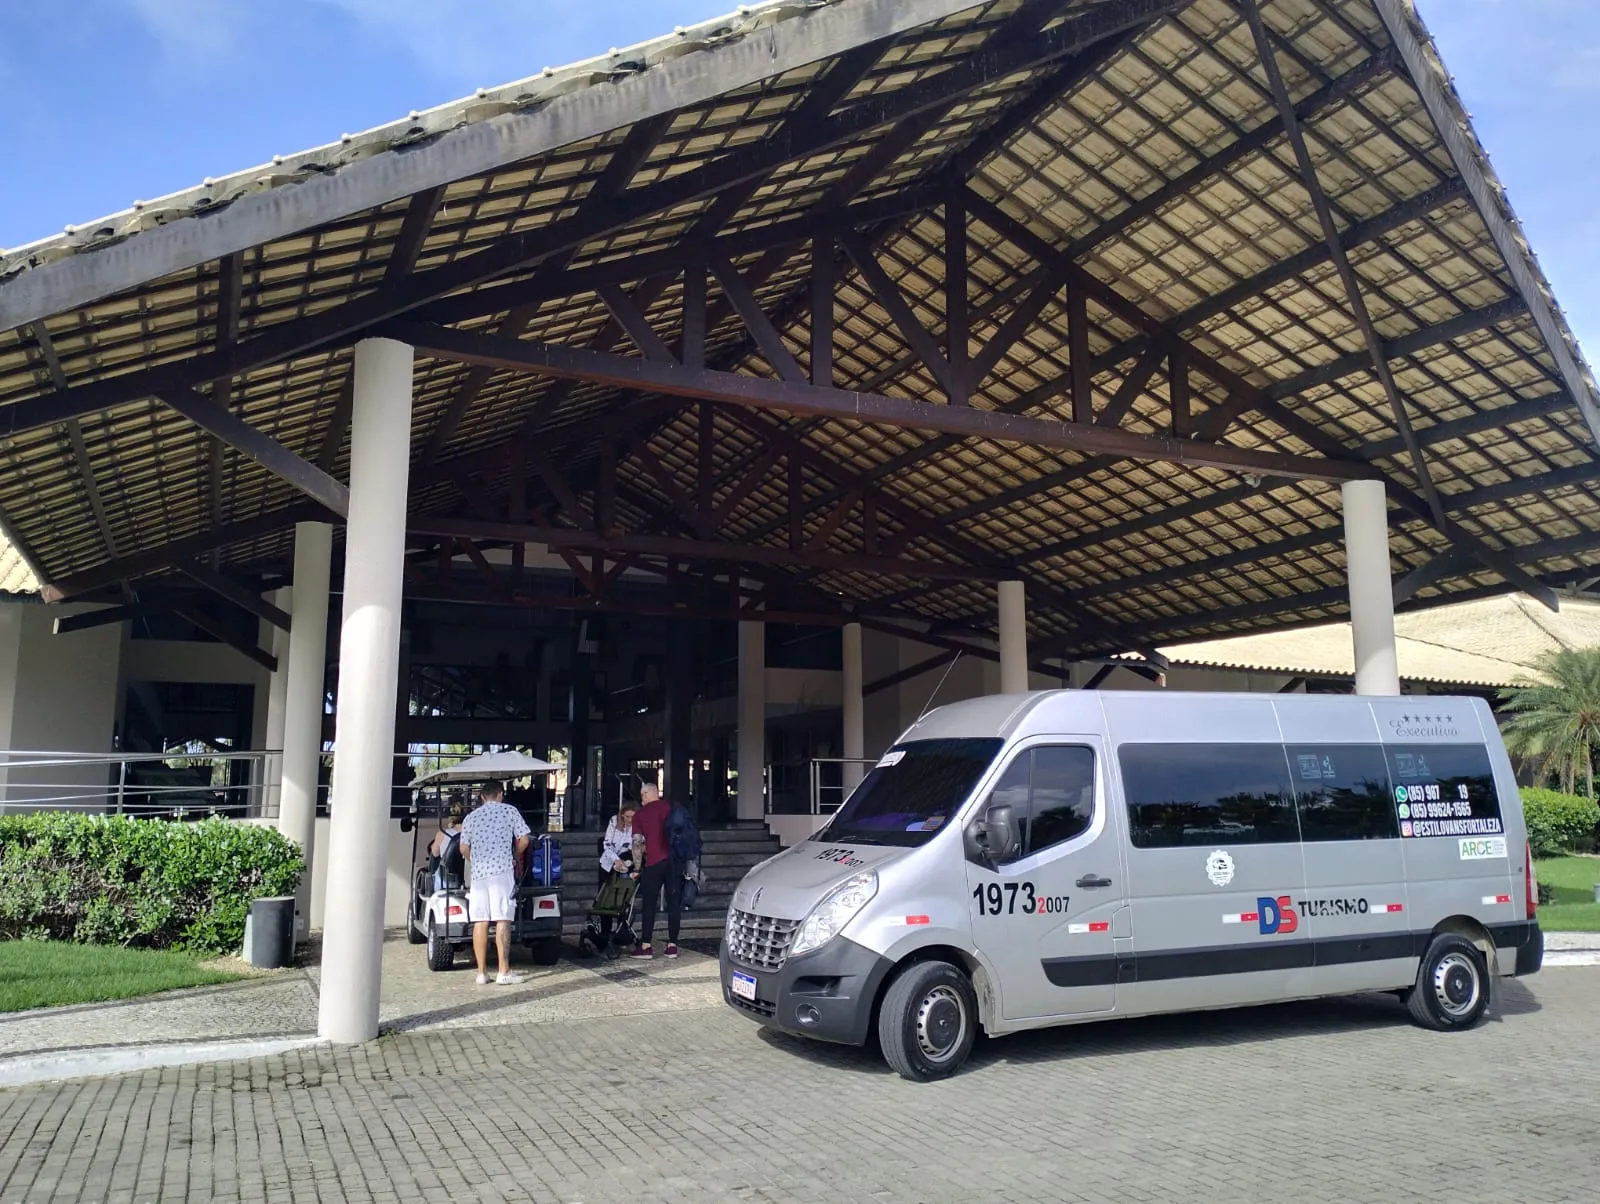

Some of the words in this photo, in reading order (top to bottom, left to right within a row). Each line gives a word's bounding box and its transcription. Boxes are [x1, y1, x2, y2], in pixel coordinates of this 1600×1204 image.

[1407, 785, 1424, 802] (85)
[1425, 785, 1440, 801] 987
[1410, 803, 1427, 818] (85)
[1462, 840, 1493, 857] ARCE
[973, 882, 1037, 915] 1973
[1037, 896, 1070, 914] 2007
[1257, 895, 1298, 935] DS
[1298, 898, 1369, 917] TURISMO
